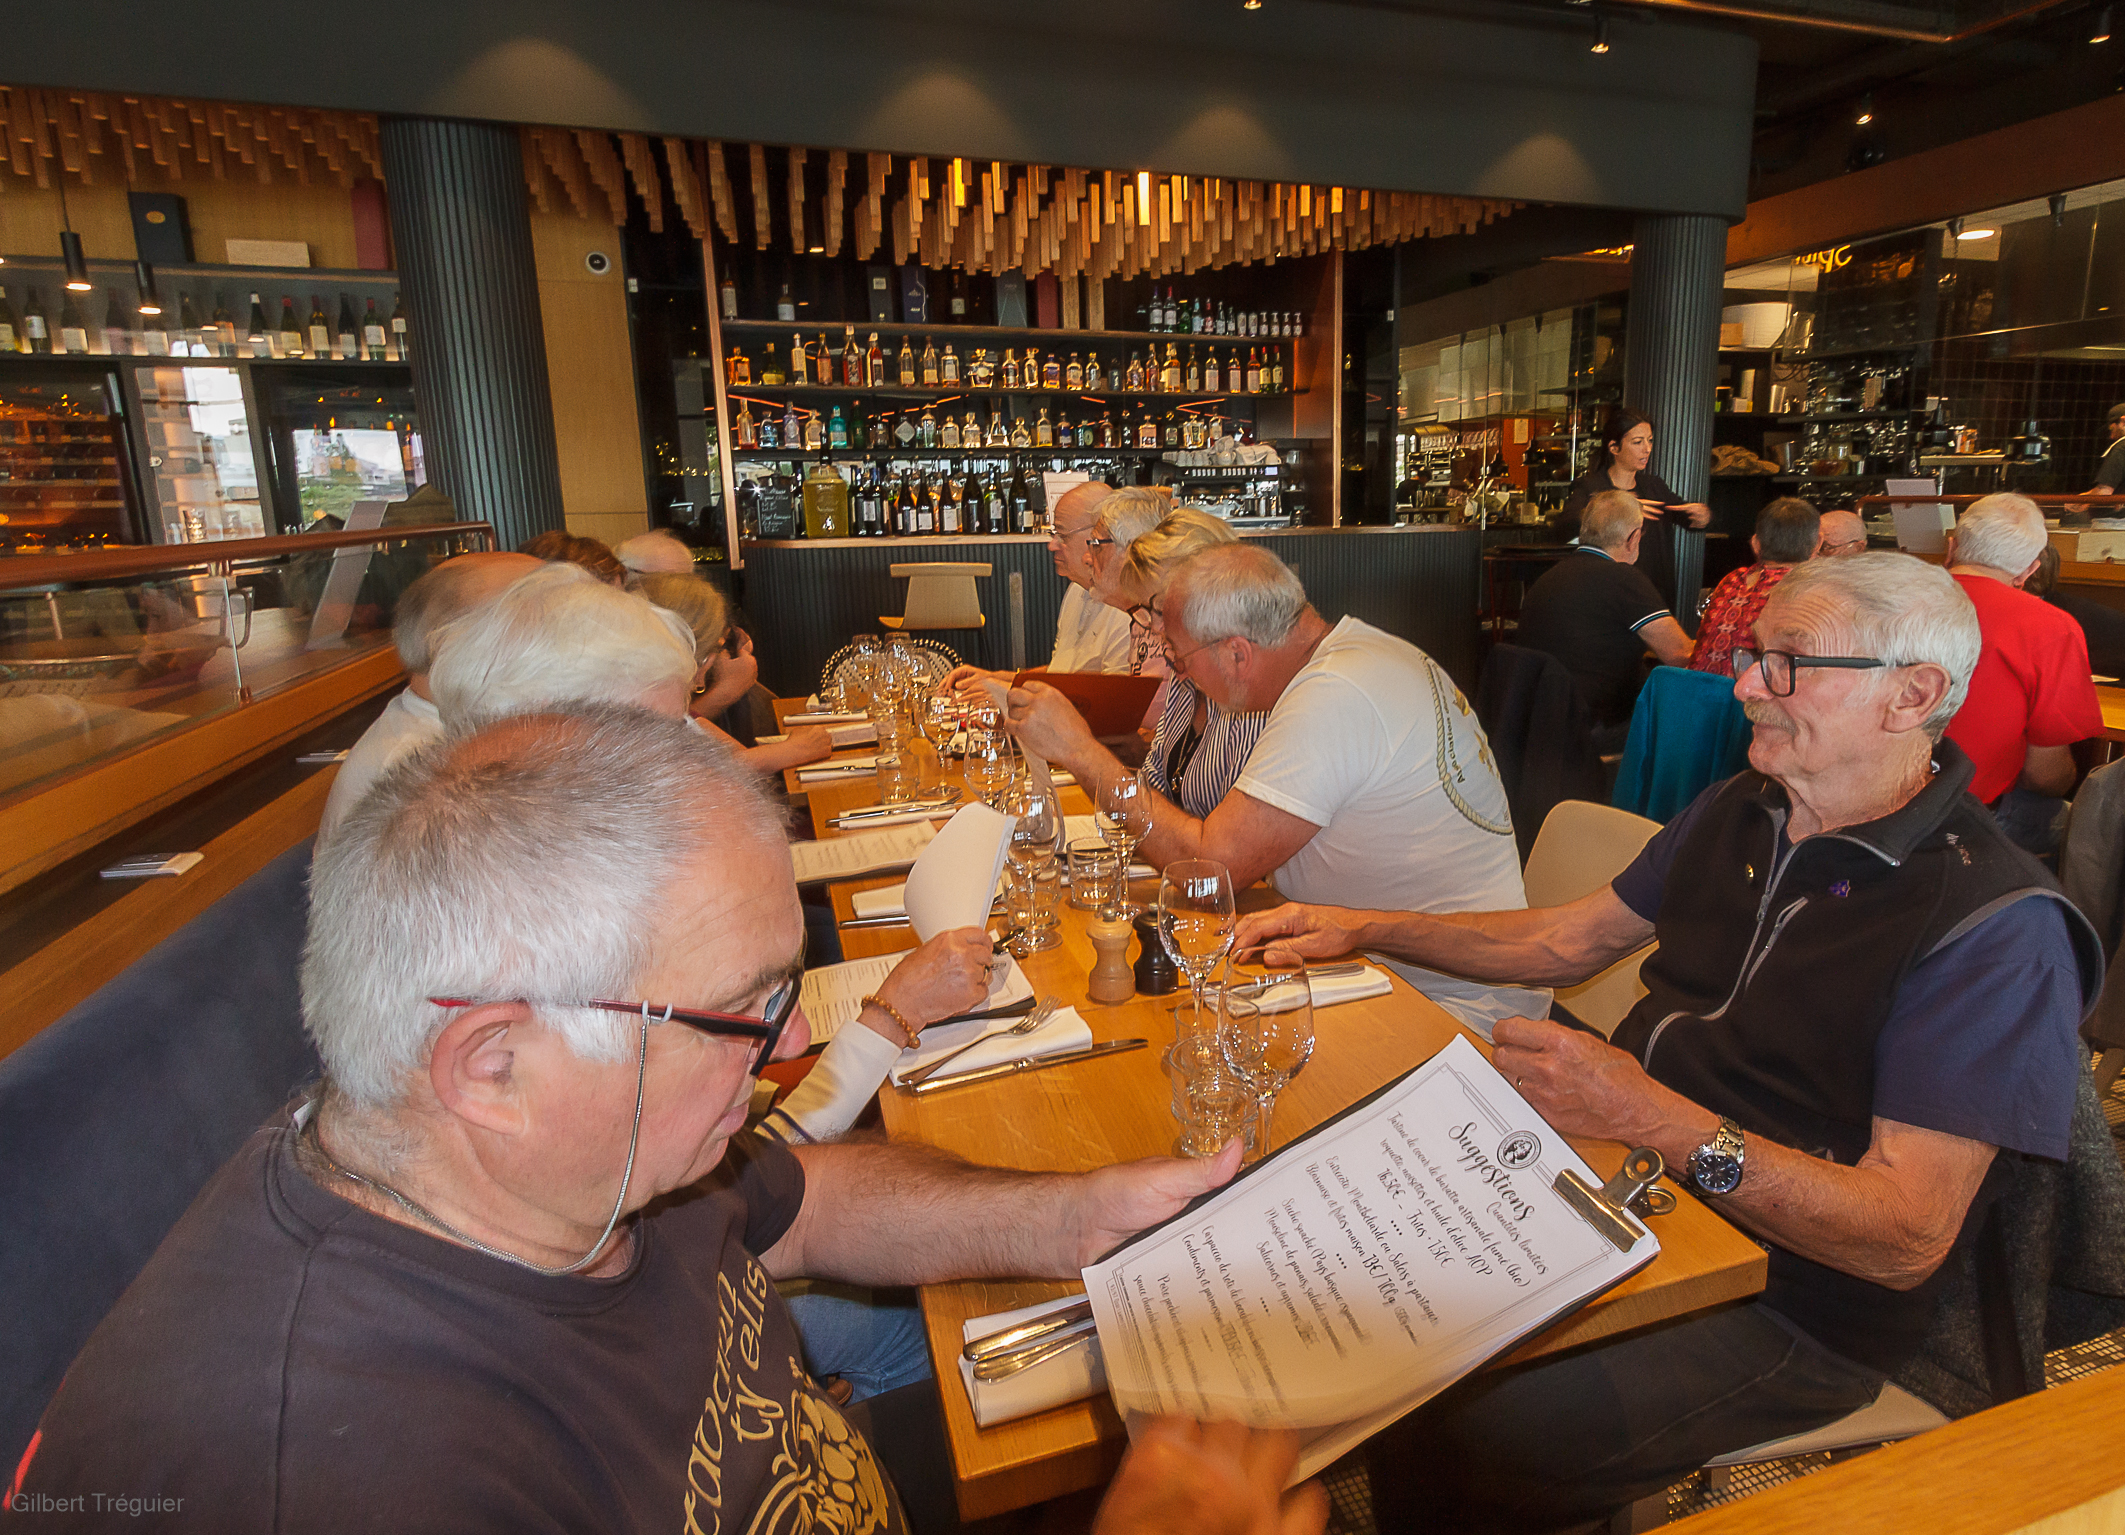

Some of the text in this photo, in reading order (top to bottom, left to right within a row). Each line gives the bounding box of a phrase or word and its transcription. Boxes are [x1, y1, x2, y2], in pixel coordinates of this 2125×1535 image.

[1448, 1121, 1534, 1221] Suggestions
[1327, 1199, 1337, 1208] et
[1327, 1205, 1348, 1229] frites
[1386, 1110, 1531, 1287] Tartine de coeur de buratta artisanale fumé (bio)
[1401, 1168, 1426, 1199] noisettes
[1423, 1198, 1435, 1206] et
[1430, 1204, 1452, 1226] huile
[1445, 1226, 1467, 1252] d'olive
[1464, 1254, 1493, 1274] AOP
[1406, 1208, 1427, 1237] Frites
[1485, 1201, 1520, 1242] Quantités
[1518, 1238, 1548, 1275] limitées
[1181, 1233, 1205, 1279] Condiments
[1200, 1278, 1210, 1287] et
[1201, 1224, 1221, 1262] Carpaccio
[1218, 1262, 1231, 1273] de
[1229, 1288, 1242, 1298] de
[1285, 1249, 1298, 1259] de
[1345, 1228, 1365, 1257] maison
[1255, 1240, 1288, 1281] Salicornes
[1275, 1281, 1286, 1289] et
[1380, 1242, 1390, 1253] ou
[1388, 1252, 1409, 1280] Salers
[1406, 1279, 1415, 1287] à
[1132, 1274, 1146, 1296] sauce
[1157, 1273, 1170, 1297] Poire
[1323, 1271, 1343, 1301] basque
